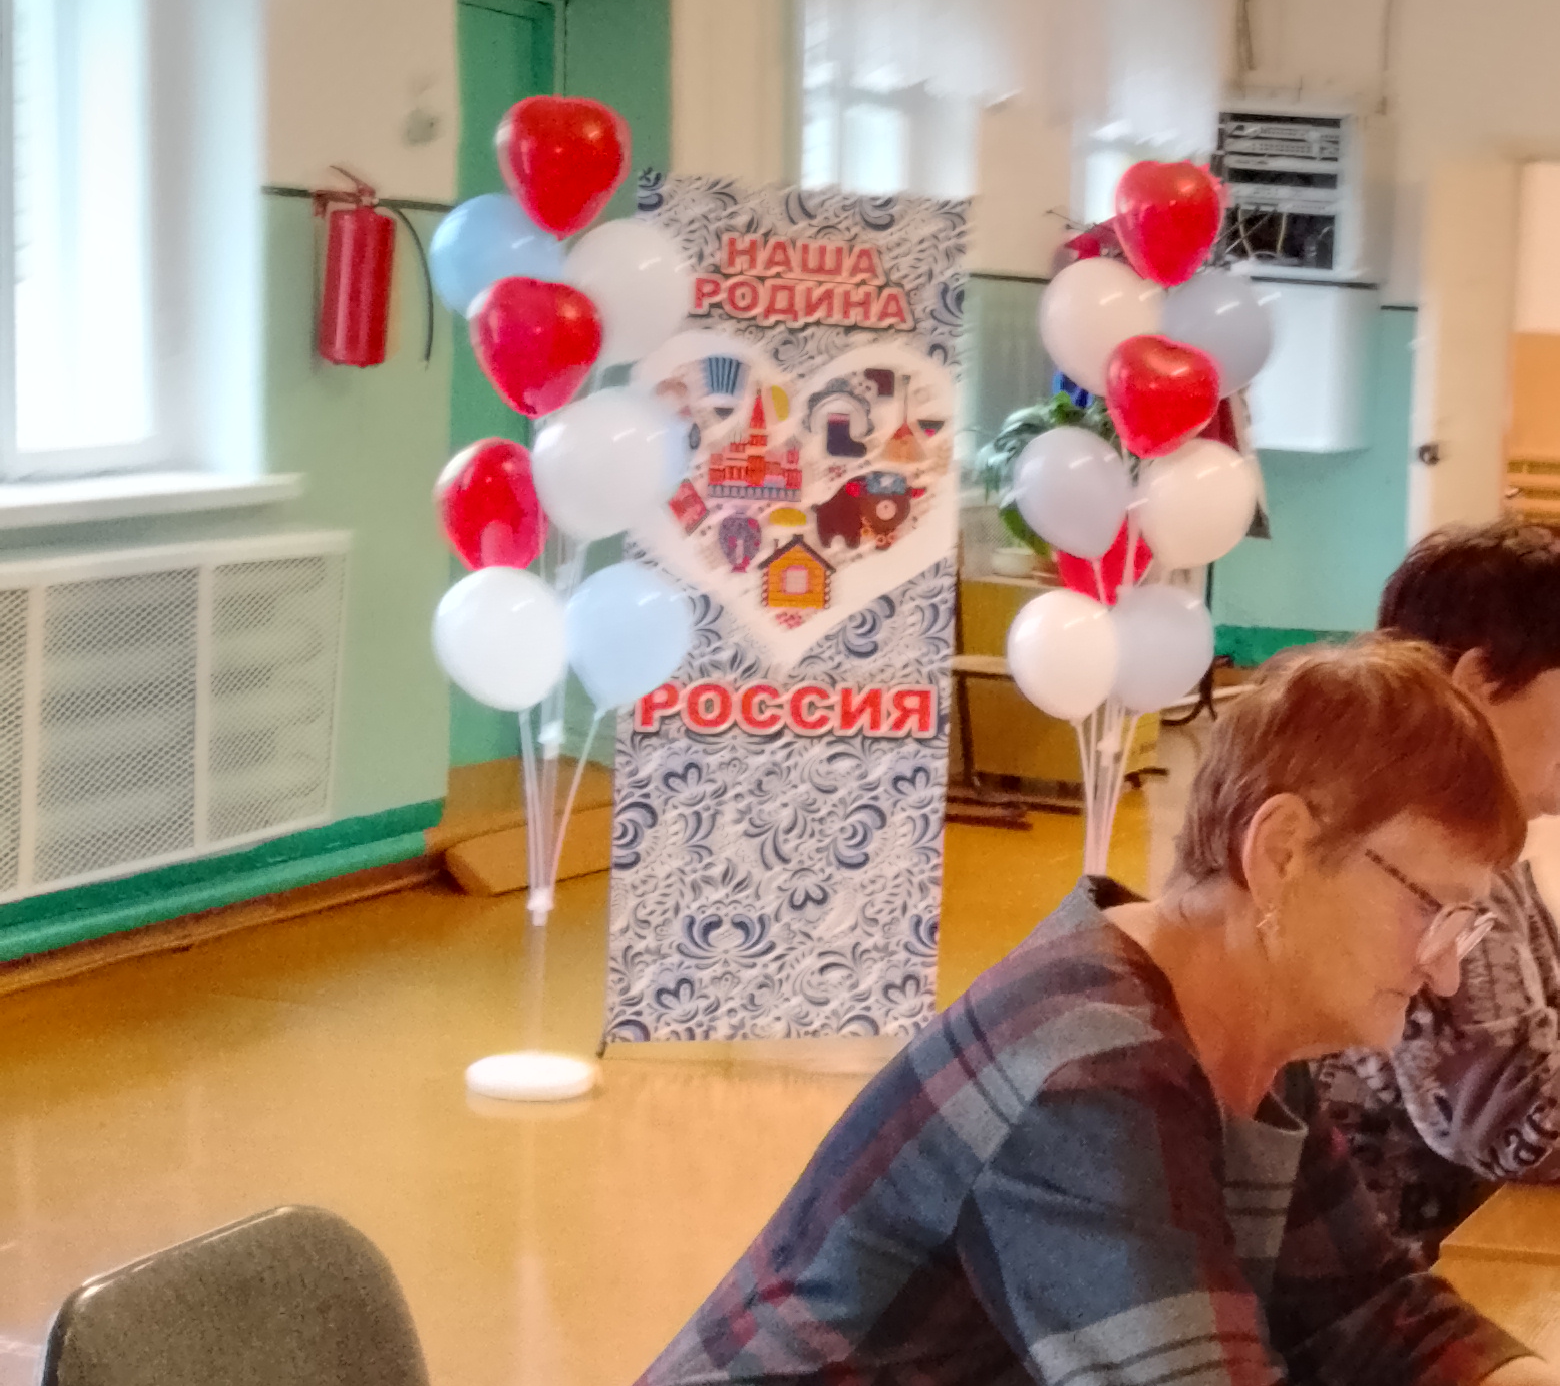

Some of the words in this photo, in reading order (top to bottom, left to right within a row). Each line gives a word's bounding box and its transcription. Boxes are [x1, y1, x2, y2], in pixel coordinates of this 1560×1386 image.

[722, 233, 884, 283] НАША
[692, 276, 911, 326] РОДИНА
[637, 682, 934, 735] РОССИЯ
